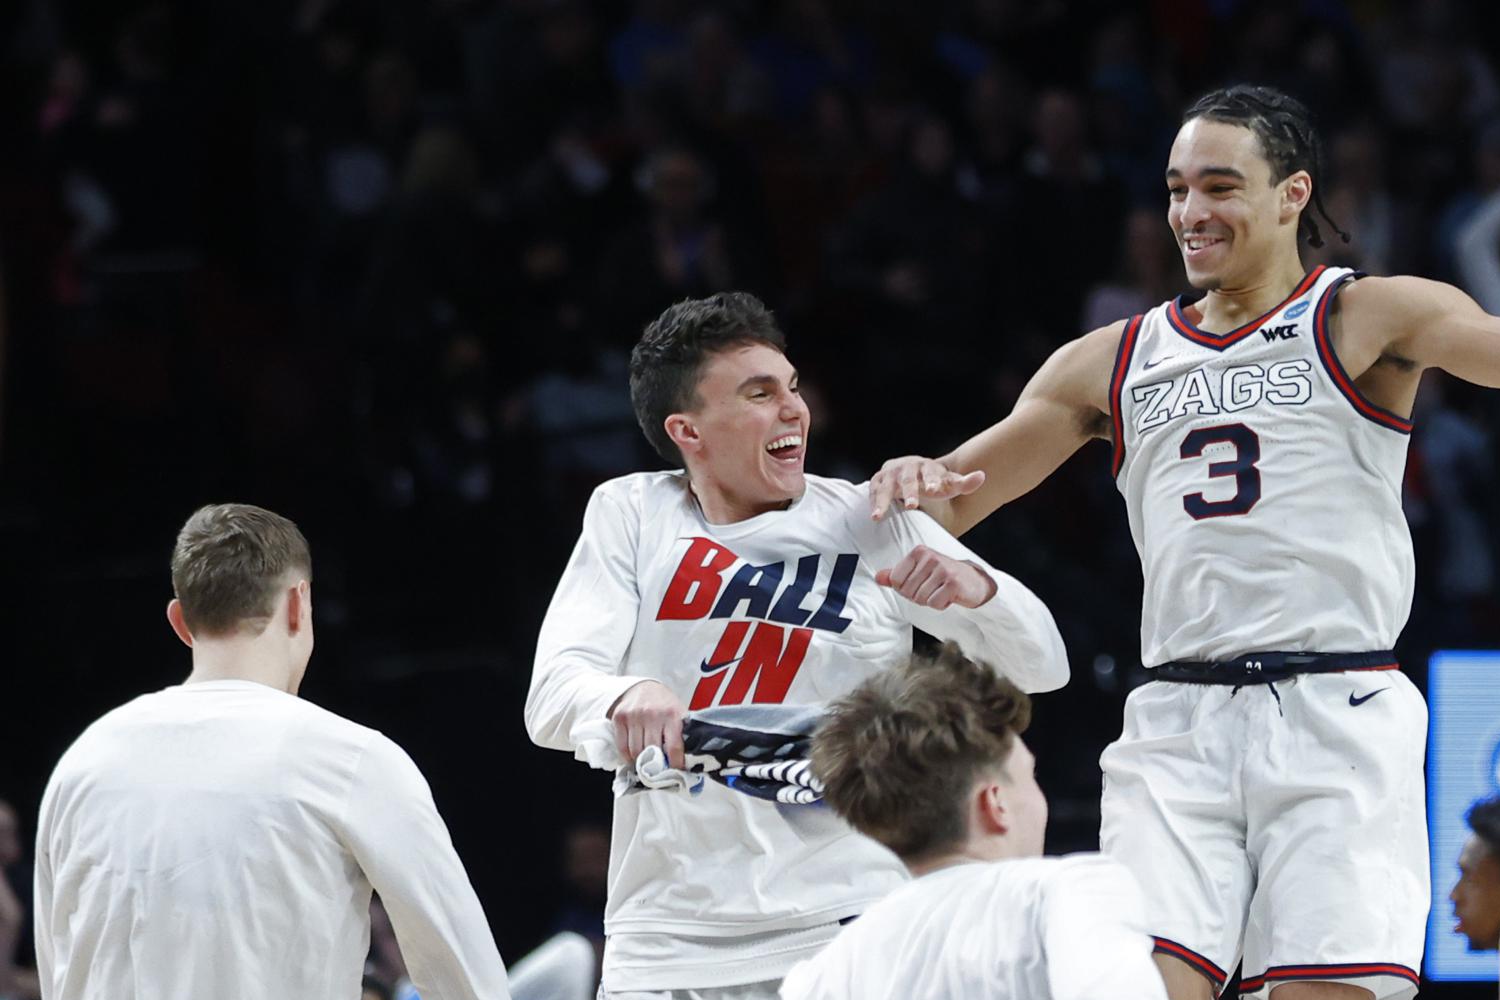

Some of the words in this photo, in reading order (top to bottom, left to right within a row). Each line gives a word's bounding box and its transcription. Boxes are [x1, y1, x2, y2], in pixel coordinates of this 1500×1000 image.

[1132, 359, 1312, 434] ZAGS
[1180, 422, 1261, 520] 3
[655, 536, 859, 634] BALL
[689, 621, 814, 711] IN
